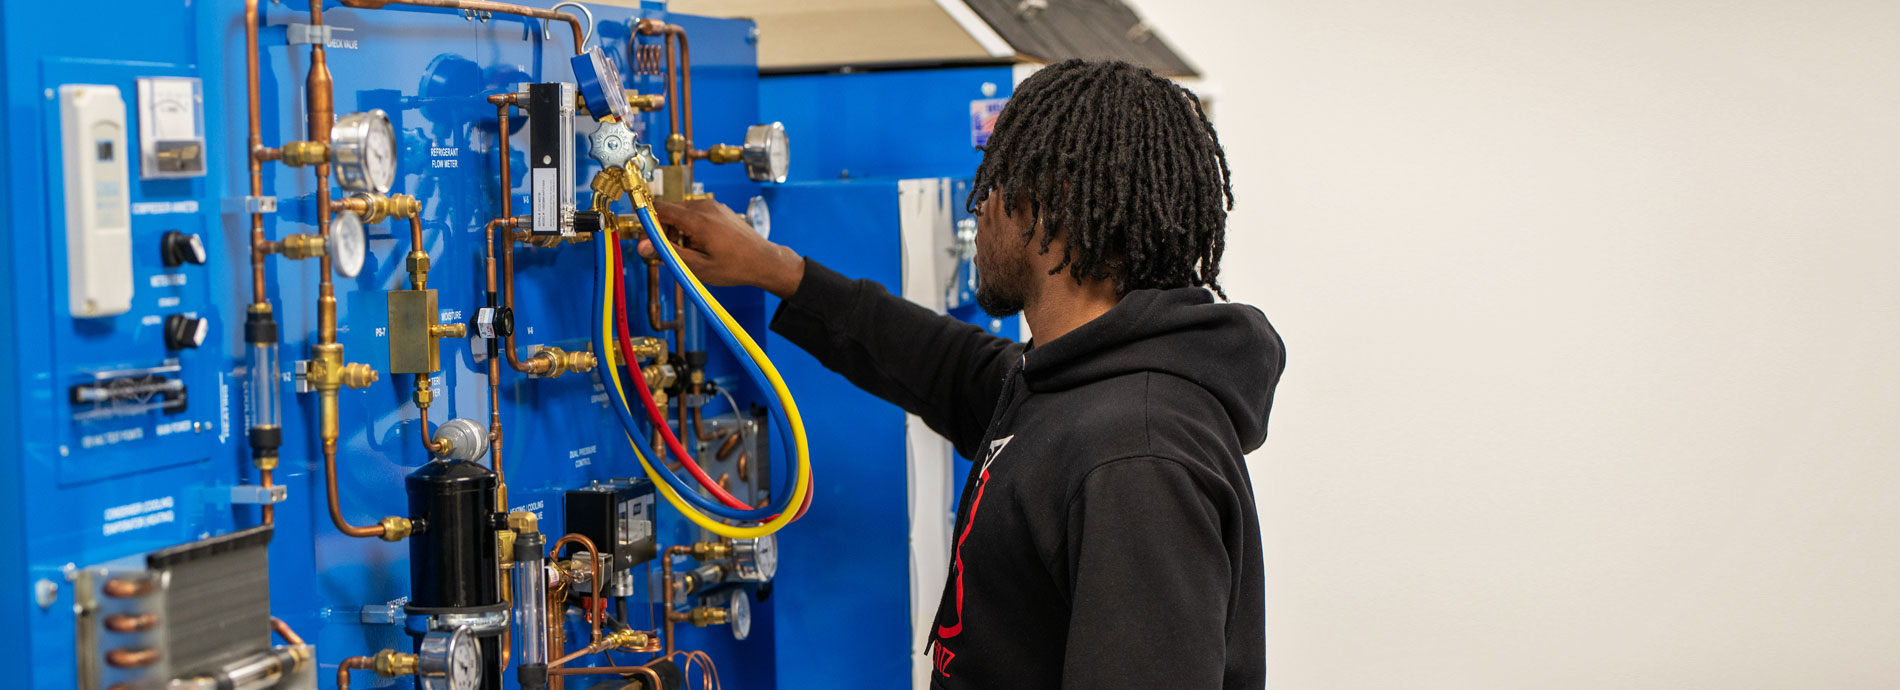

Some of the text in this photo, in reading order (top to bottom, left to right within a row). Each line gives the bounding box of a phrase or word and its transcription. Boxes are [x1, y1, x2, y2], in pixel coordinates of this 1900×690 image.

[327, 39, 358, 49] CHECK VALVE
[610, 128, 630, 152] JACKET
[430, 148, 458, 156] REFRIGERANT
[432, 160, 458, 168] FLOW METER
[441, 310, 462, 321] MOISTURE
[569, 445, 597, 459] DUAL PRESSURE
[575, 457, 591, 468] CONTROL
[528, 500, 544, 511] COOLING
